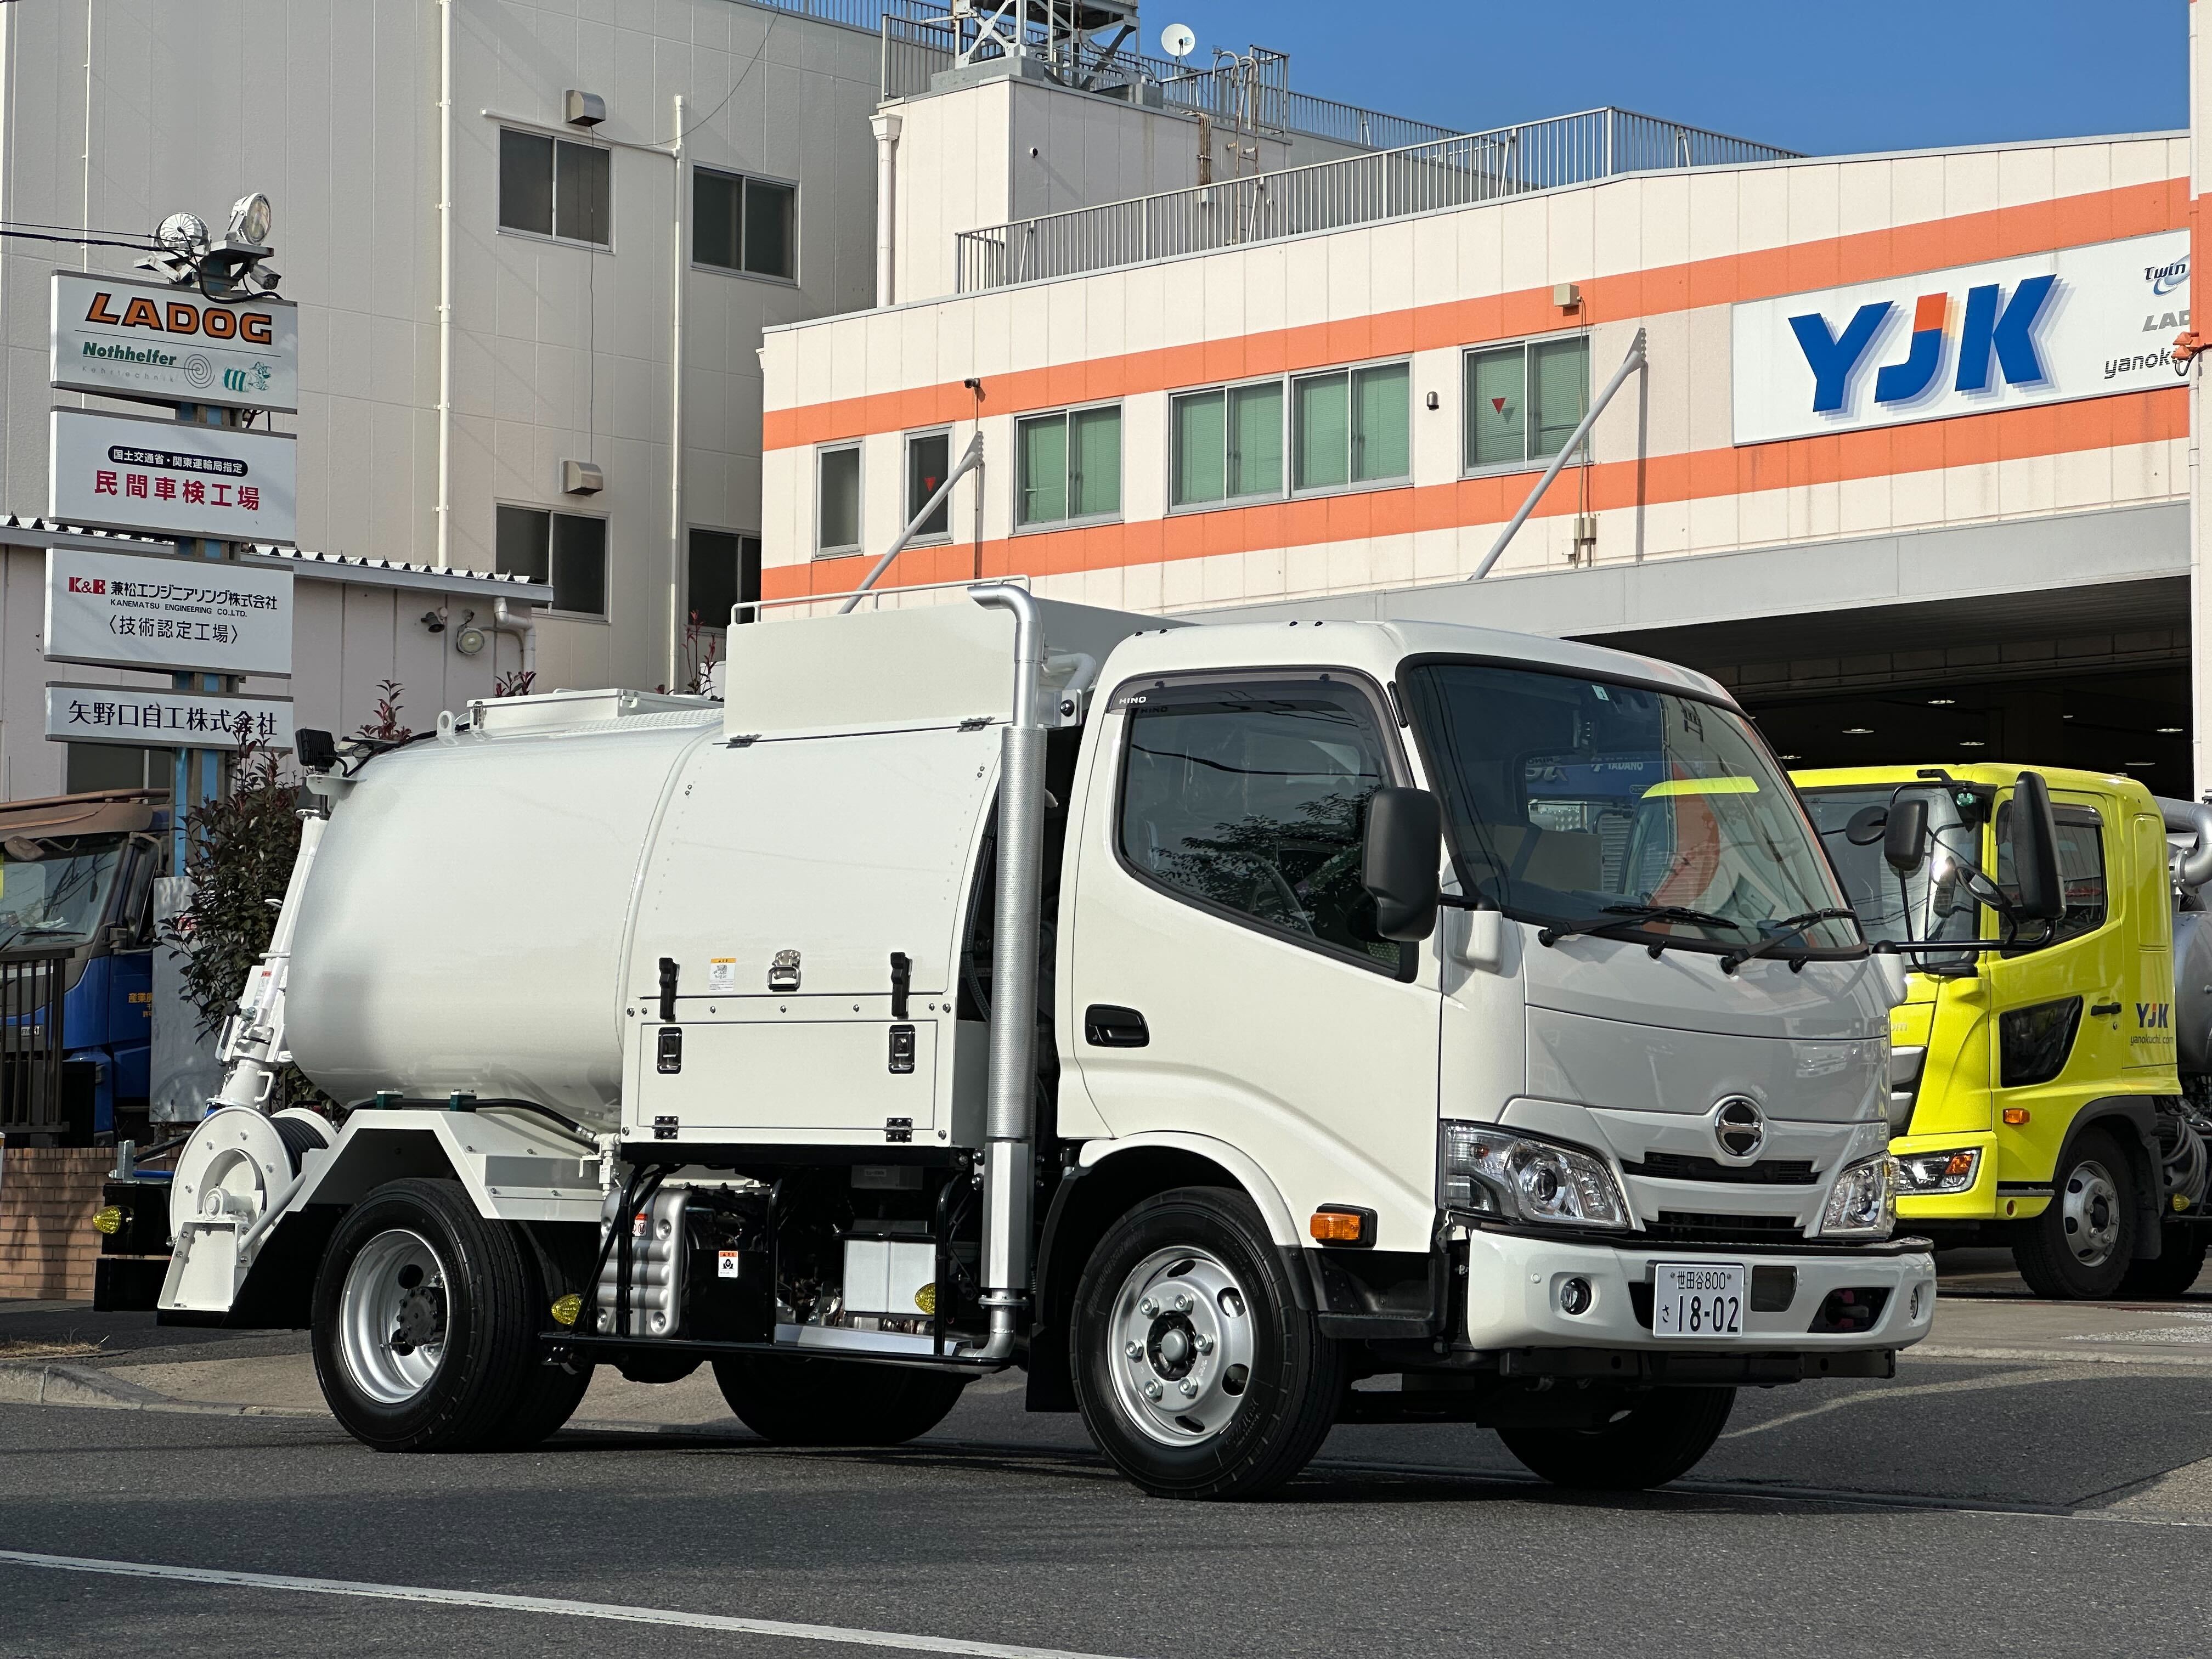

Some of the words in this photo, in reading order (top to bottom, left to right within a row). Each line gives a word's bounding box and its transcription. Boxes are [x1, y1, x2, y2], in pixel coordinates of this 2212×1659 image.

[2144, 263, 2186, 280] Twin
[84, 292, 272, 345] LADOG
[82, 341, 177, 365] Nothhelfer
[1788, 274, 2066, 417] YJK
[82, 366, 175, 383] Kehrtechnik
[2104, 348, 2176, 379] yanok
[113, 449, 243, 475] 国土交通省・関東運輸局指定
[94, 470, 259, 511] 民間車検工場
[110, 581, 278, 610] 兼松エンジニアリング株式会社
[110, 599, 160, 610] KANEMATSU
[165, 604, 212, 614] ENGINEERING
[69, 700, 278, 735] 矢野口自工株式会社
[1608, 762, 1644, 771] TADANO
[2136, 1003, 2169, 1028] YJK
[1662, 1304, 1669, 1323] さ
[1678, 1295, 1739, 1333] 18-02
